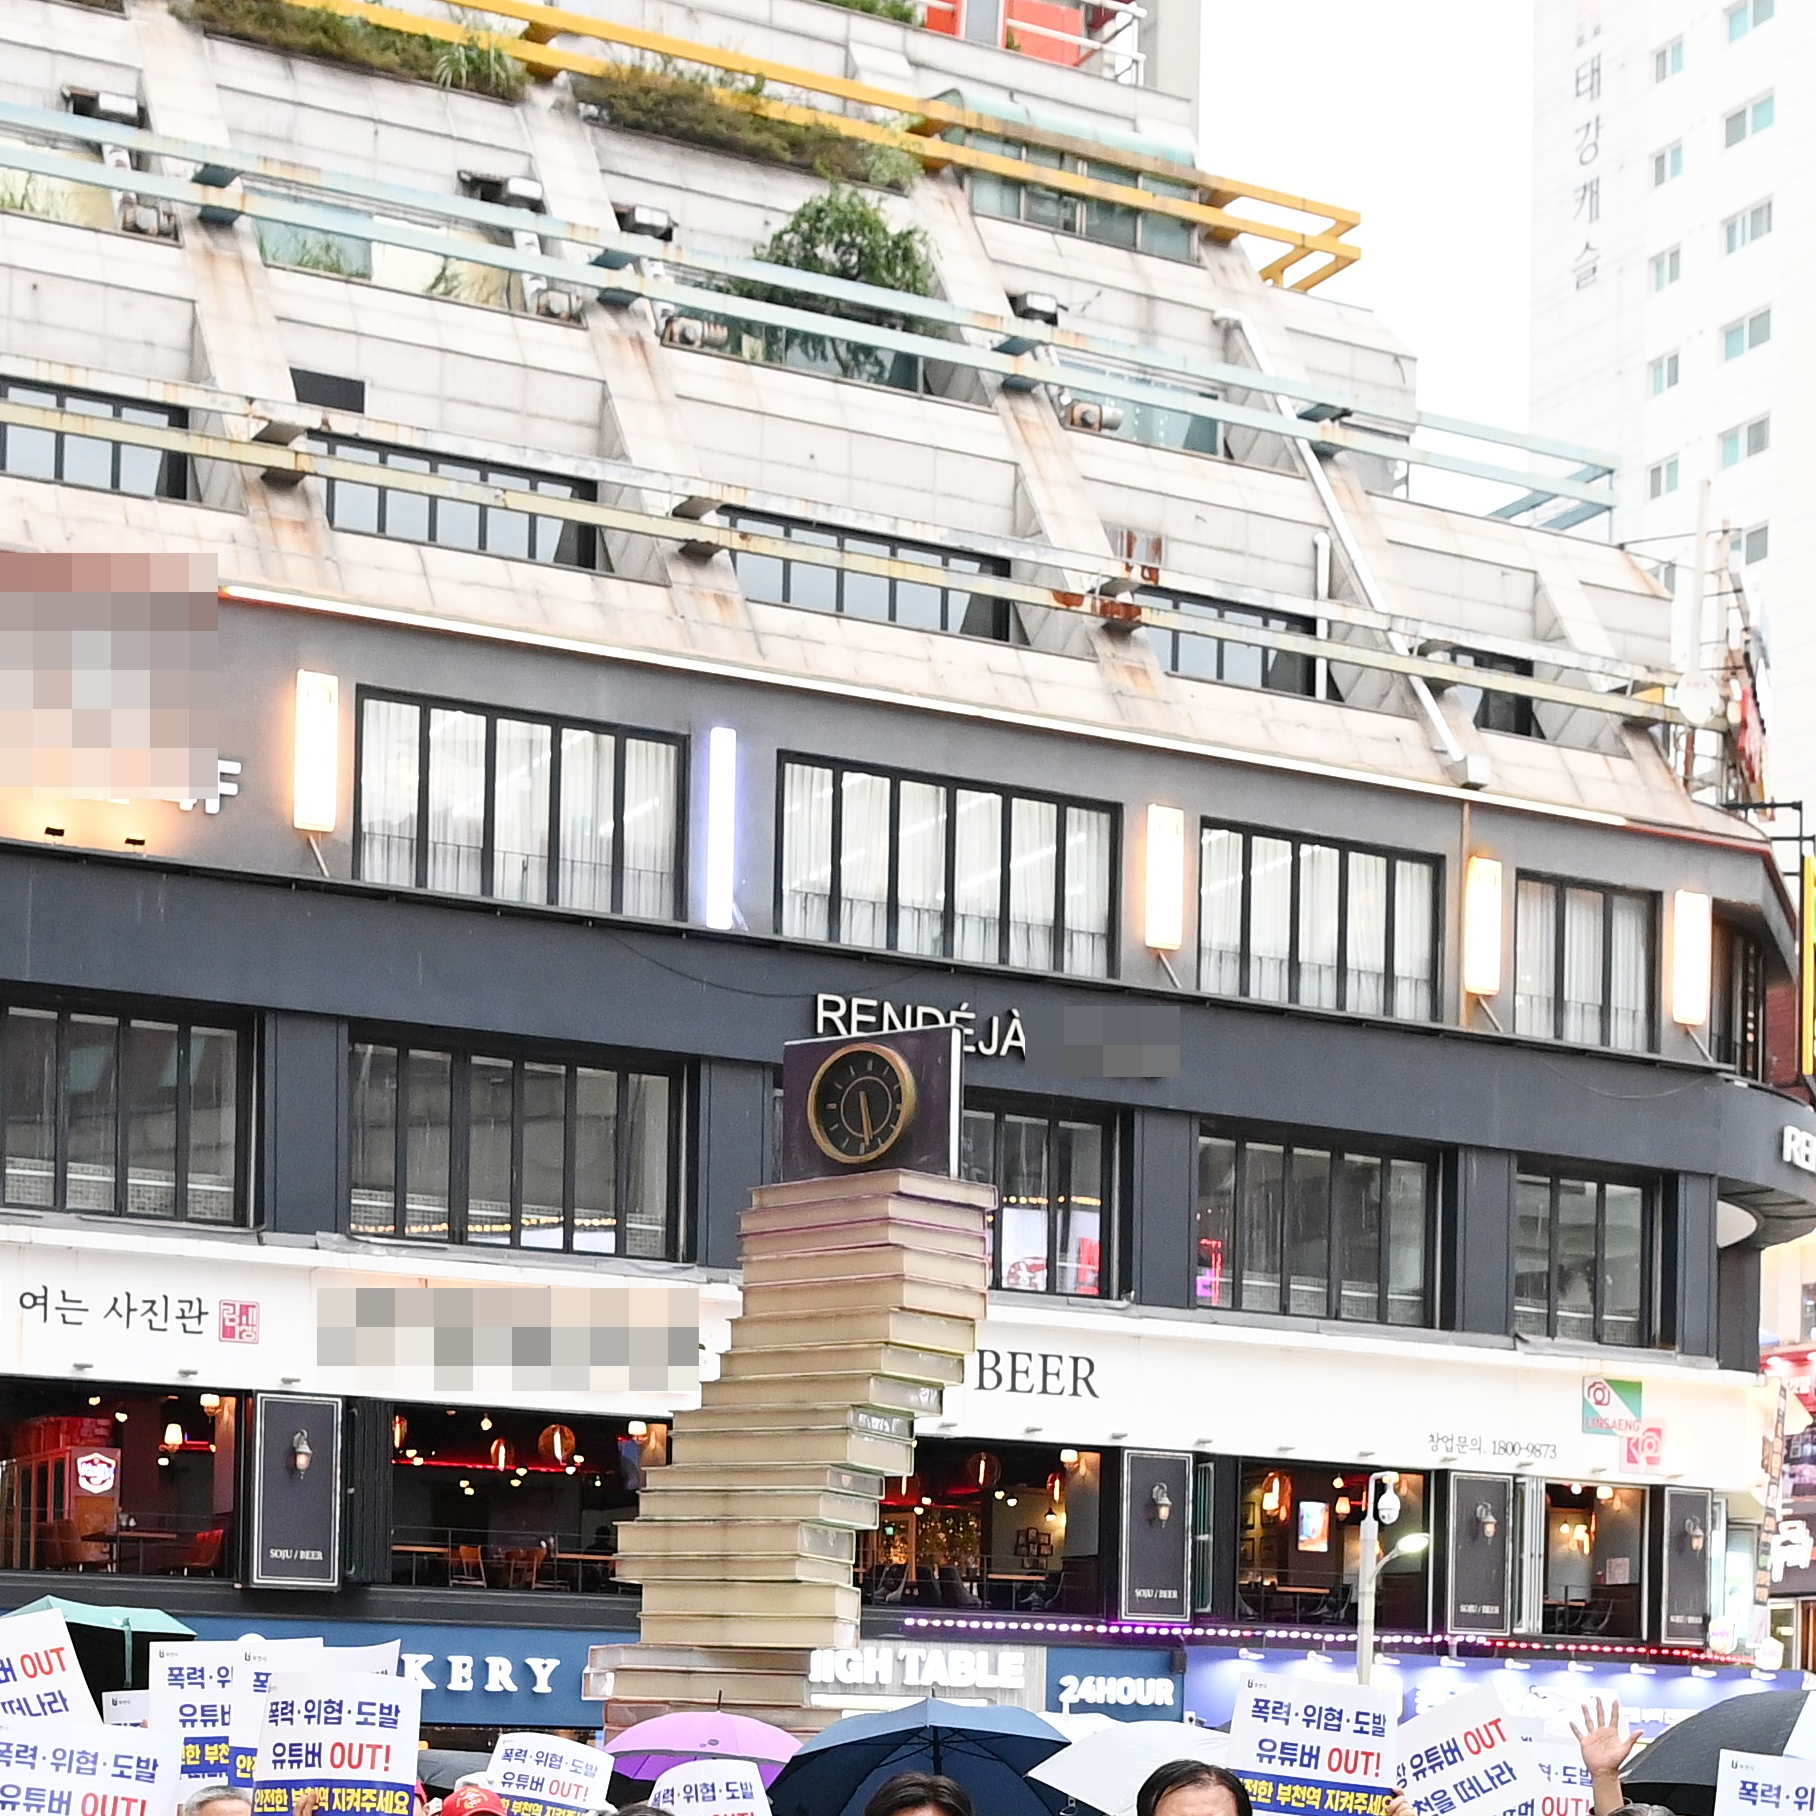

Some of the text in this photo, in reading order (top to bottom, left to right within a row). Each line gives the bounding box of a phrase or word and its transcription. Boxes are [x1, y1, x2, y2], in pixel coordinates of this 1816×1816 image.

[18, 1283, 90, 1327] 여는
[103, 1292, 210, 1338] 사진관
[976, 1348, 1100, 1400] BEER
[897, 1647, 1026, 1690] TABLE
[1058, 1674, 1176, 1706] 24HOUR
